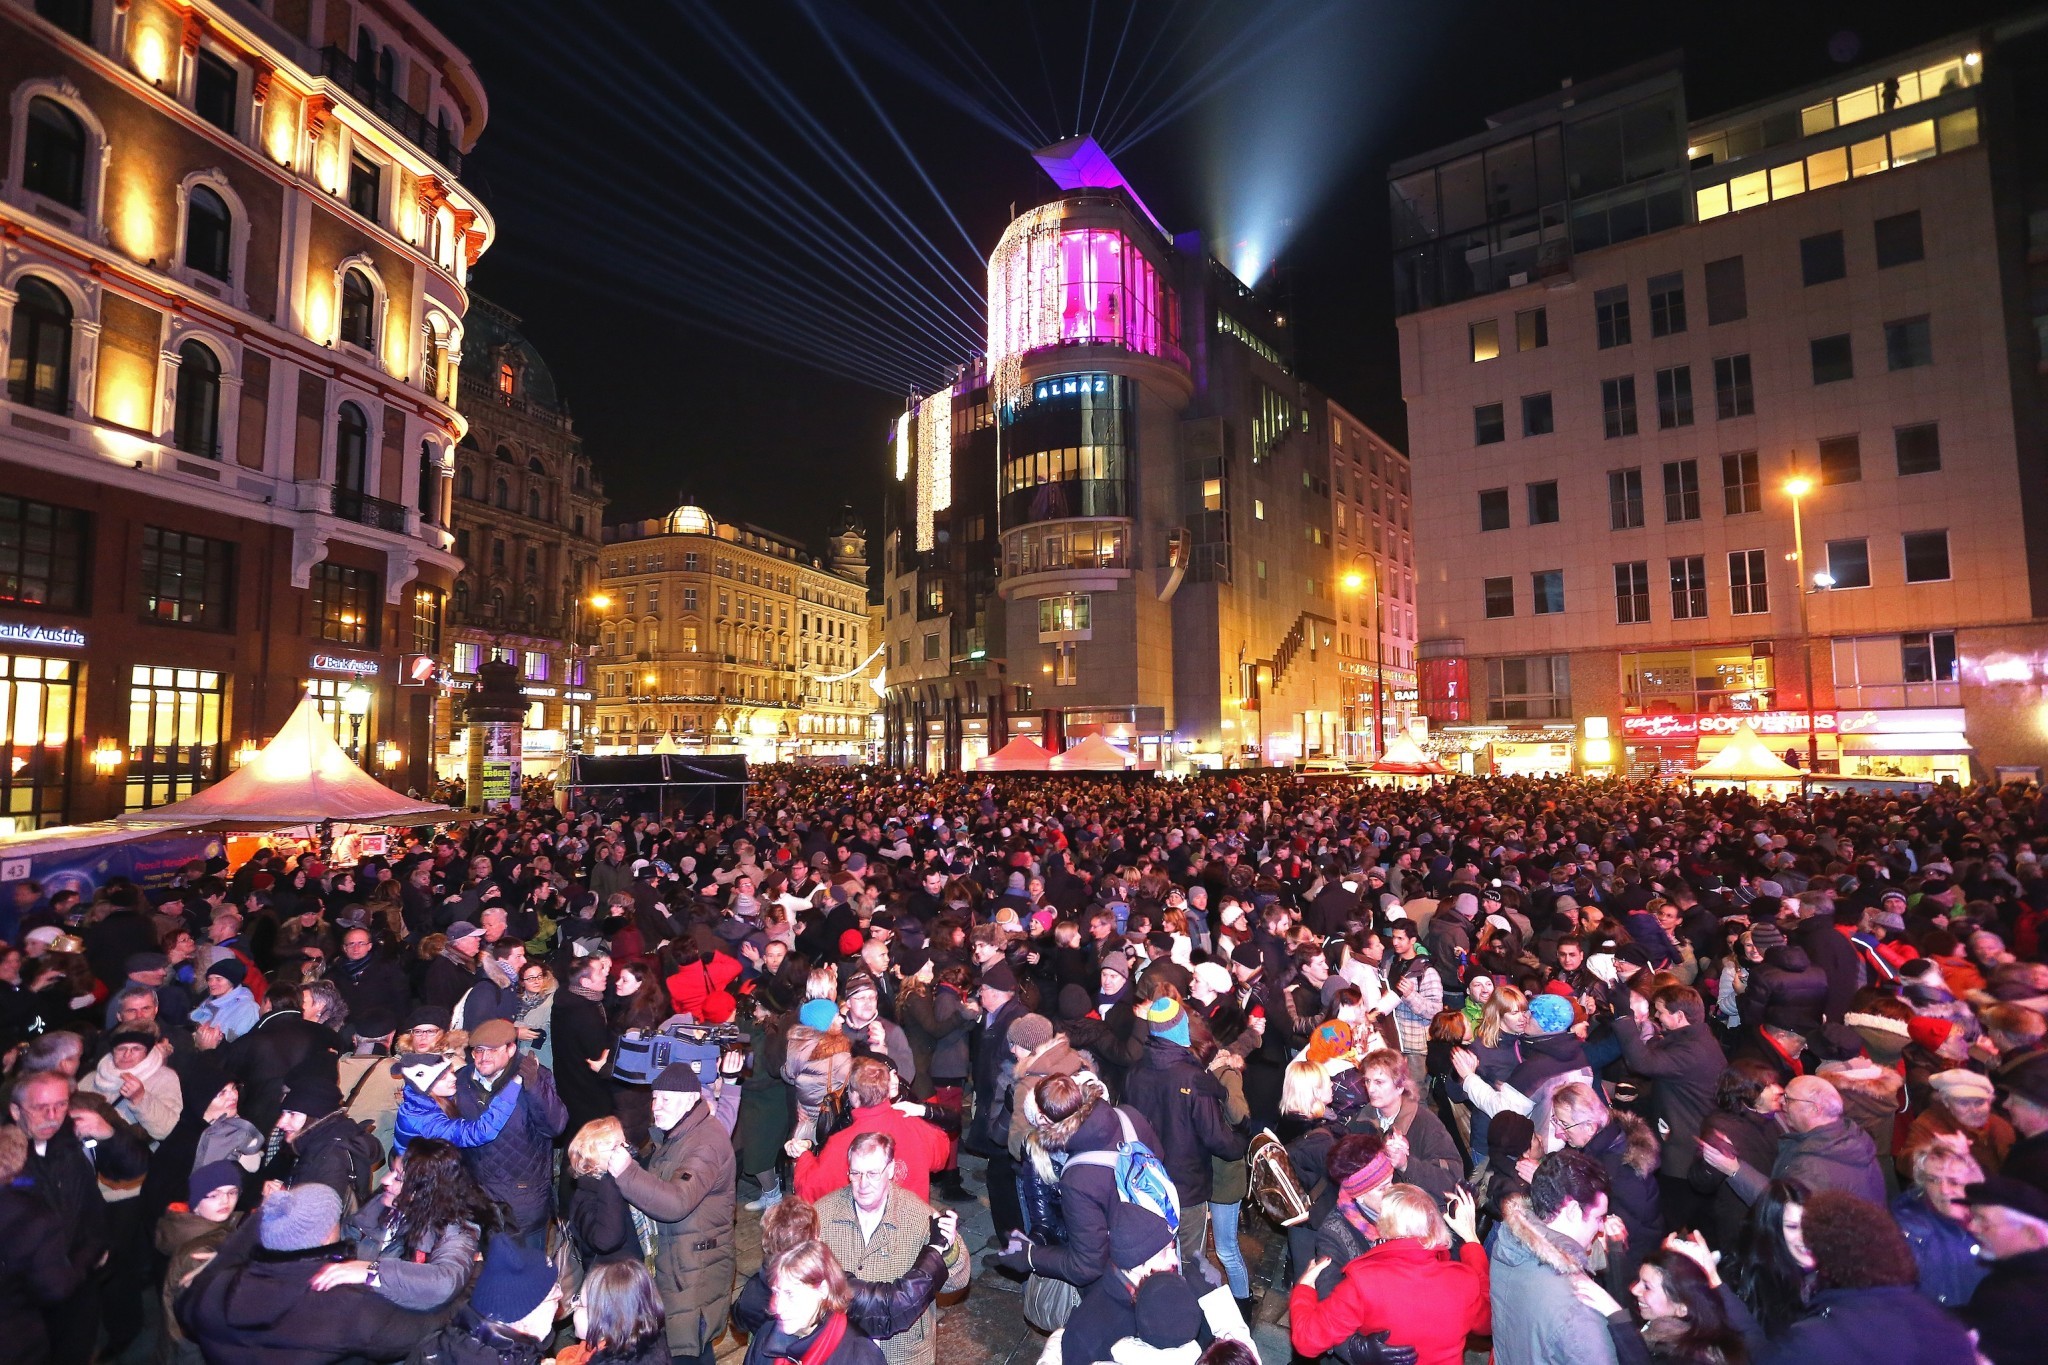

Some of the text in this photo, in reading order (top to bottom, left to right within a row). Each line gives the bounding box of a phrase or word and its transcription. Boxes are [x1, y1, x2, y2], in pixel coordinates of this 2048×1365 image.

[1039, 381, 1104, 398] ALMAZ
[0, 624, 86, 645] ank Austria
[327, 657, 379, 672] Bank Austria
[7, 864, 25, 878] 43
